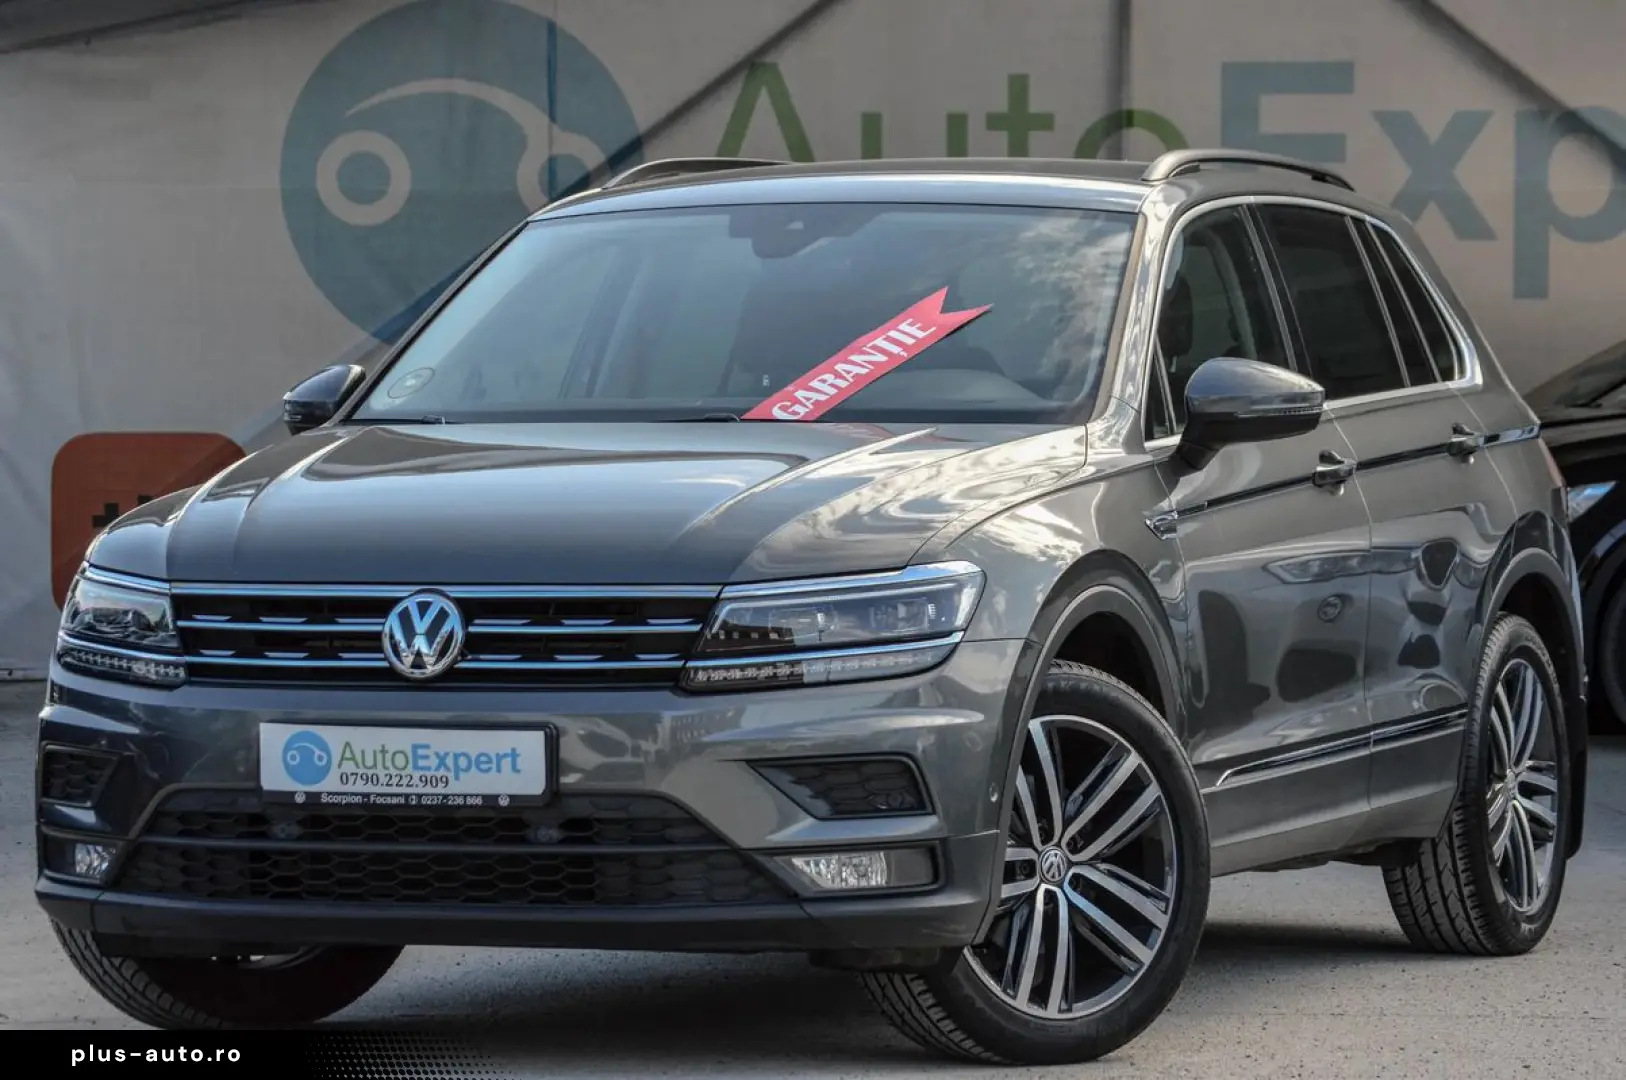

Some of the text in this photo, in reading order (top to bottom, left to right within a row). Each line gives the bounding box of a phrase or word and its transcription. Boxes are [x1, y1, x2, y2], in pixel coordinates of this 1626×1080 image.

[772, 318, 936, 420] GARANȚIE
[383, 593, 463, 678] VW
[337, 741, 521, 780] AutoExpert
[340, 772, 450, 788] 0790.222.909
[321, 792, 362, 805] Scorpion
